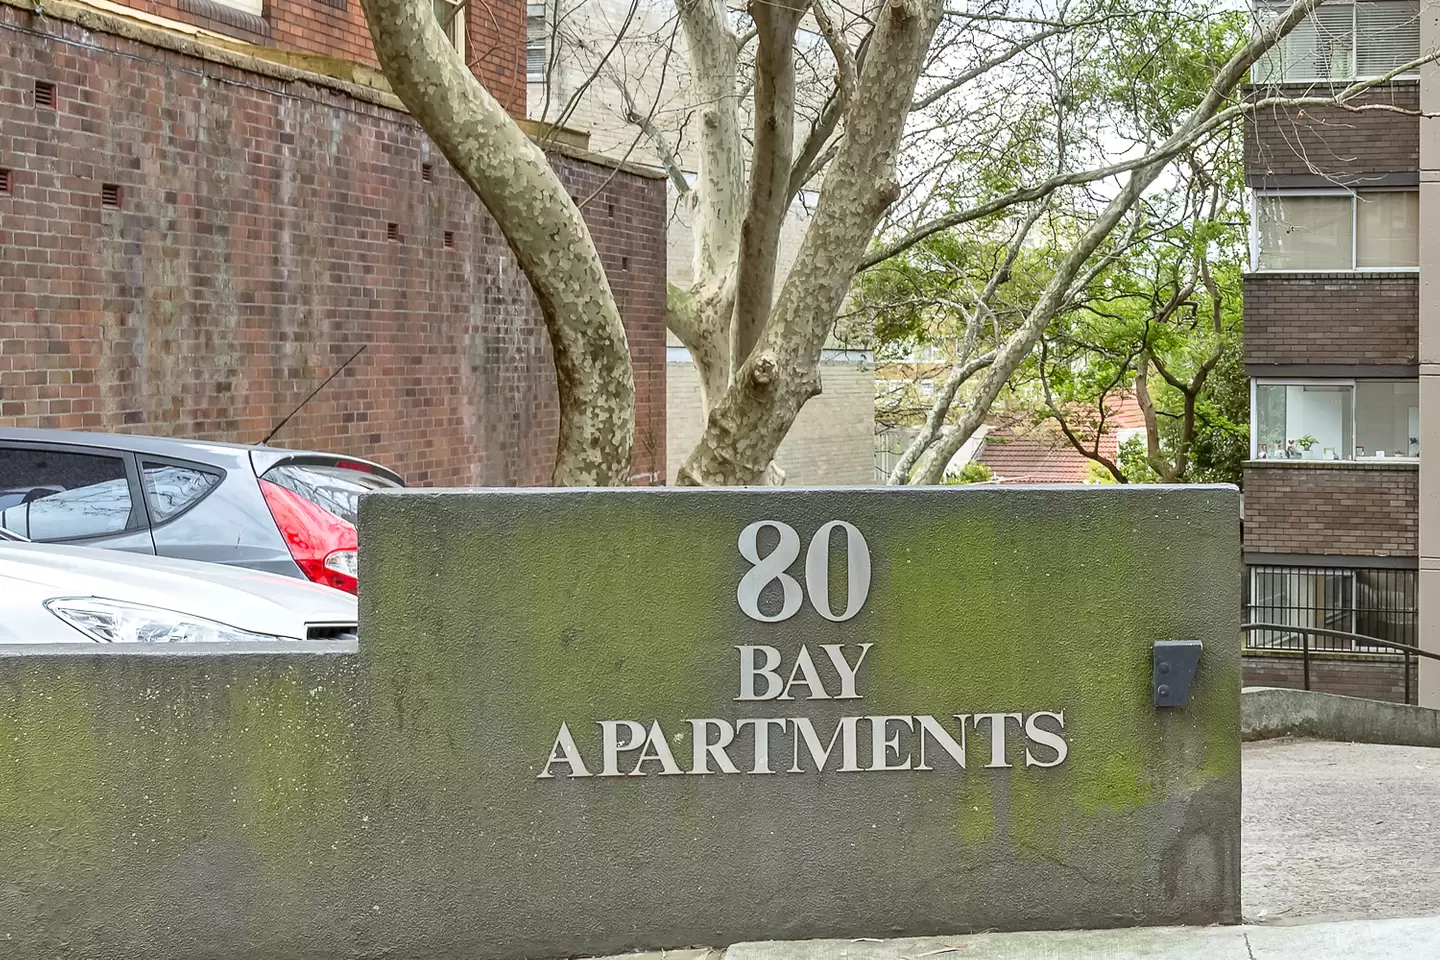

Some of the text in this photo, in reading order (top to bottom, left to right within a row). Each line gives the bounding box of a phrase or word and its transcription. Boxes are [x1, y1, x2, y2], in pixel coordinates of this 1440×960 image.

[737, 520, 872, 623] 80
[734, 643, 873, 701] BAY
[537, 711, 1069, 778] APARTMENTS
